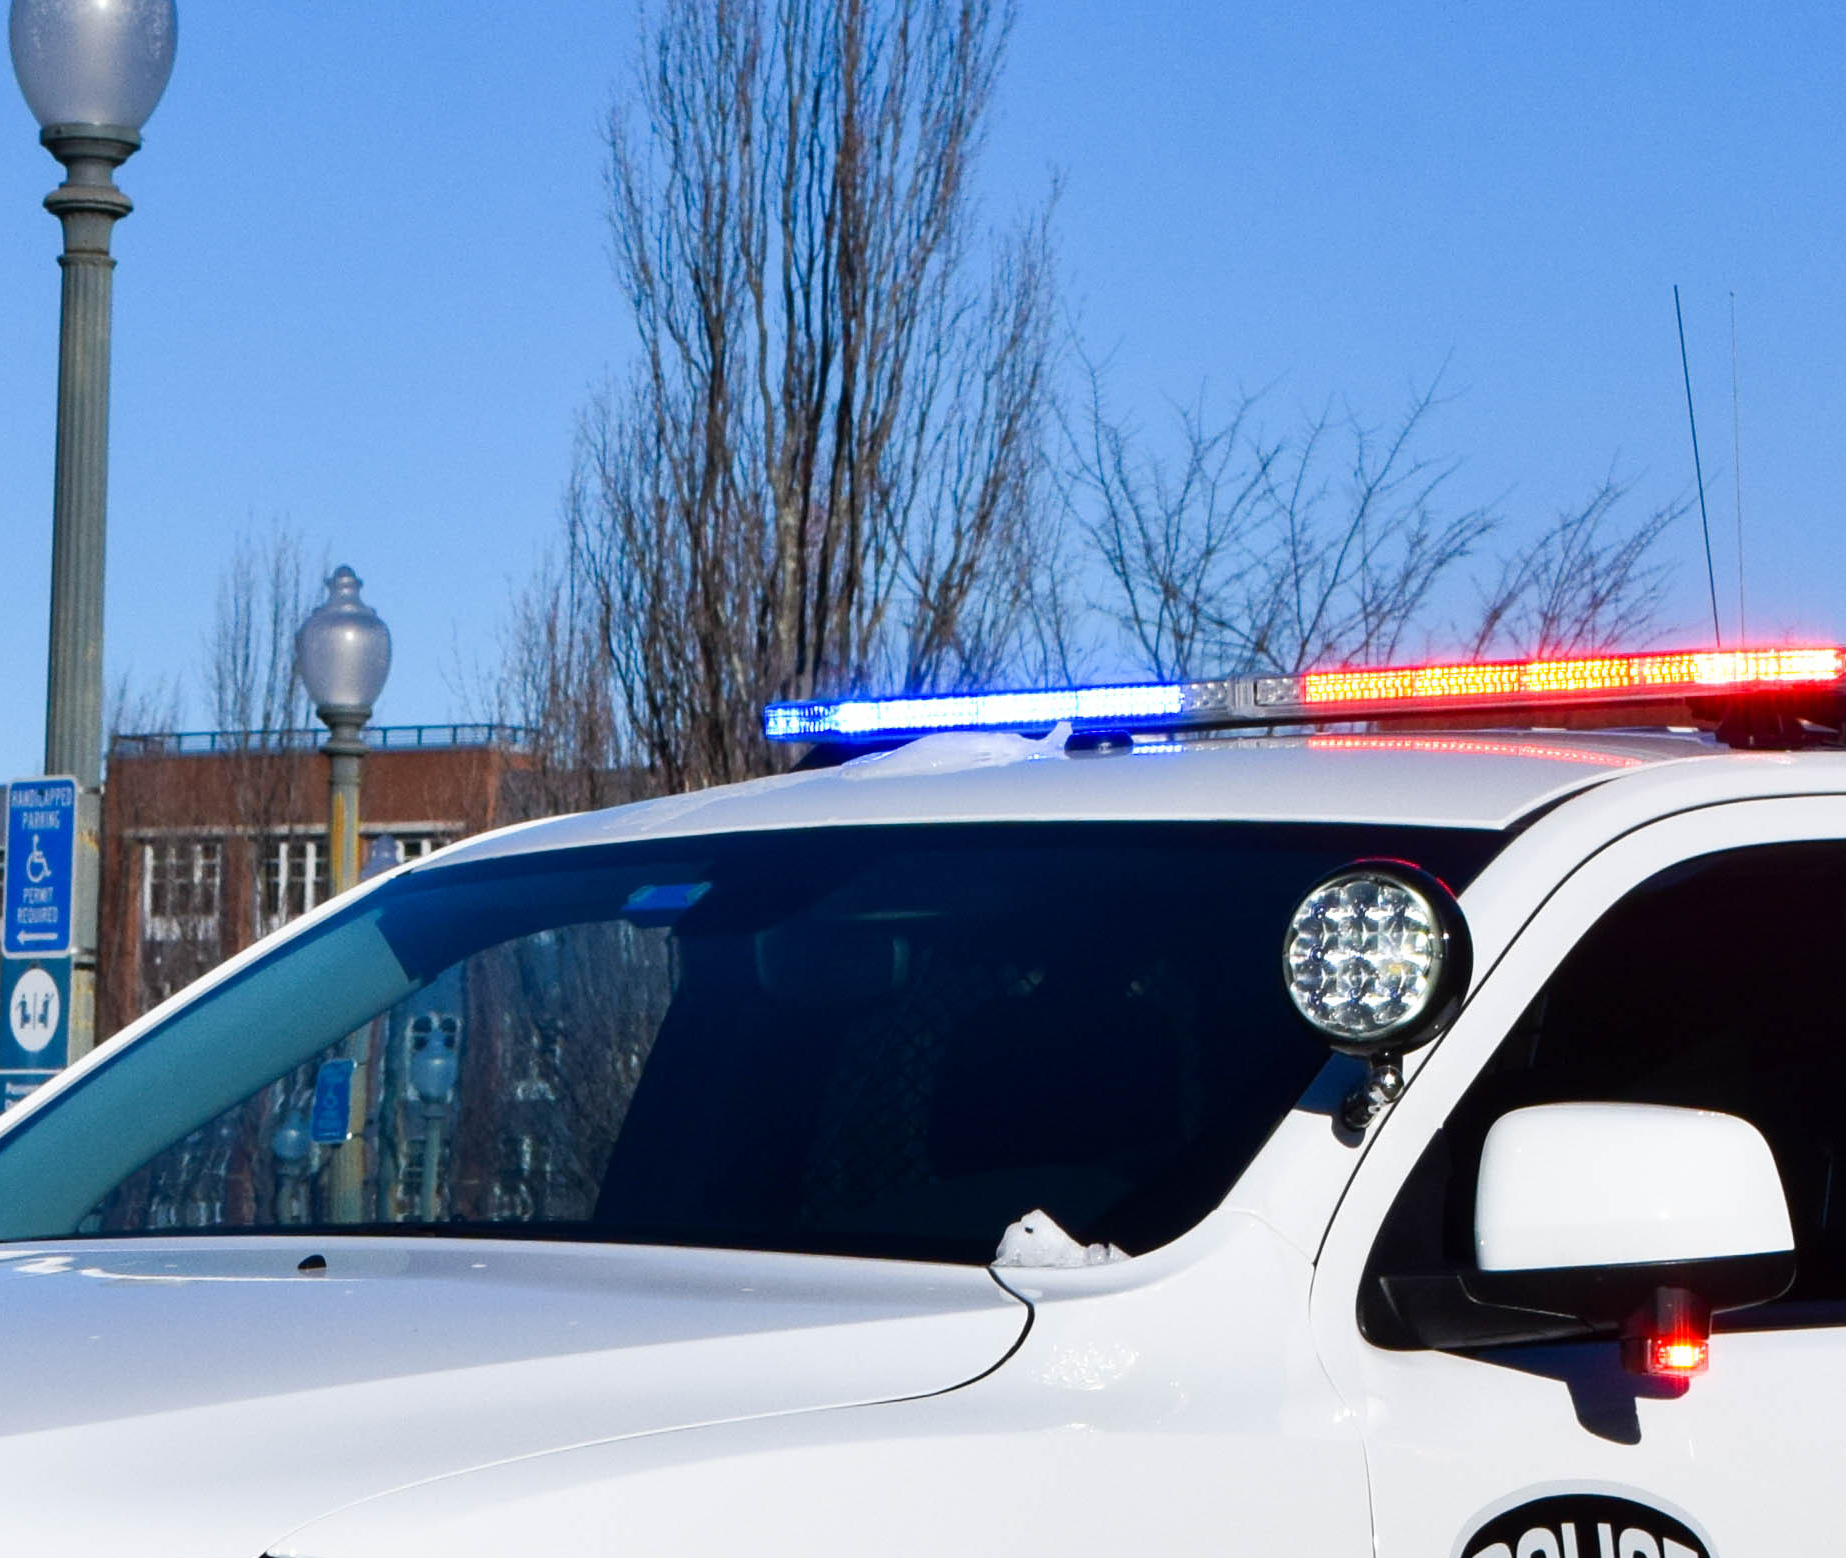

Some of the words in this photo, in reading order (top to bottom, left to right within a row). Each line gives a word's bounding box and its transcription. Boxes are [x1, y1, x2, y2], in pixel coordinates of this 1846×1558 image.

[22, 810, 60, 829] PARKING
[23, 887, 54, 903] PERMIT
[17, 907, 59, 923] REQUIRED
